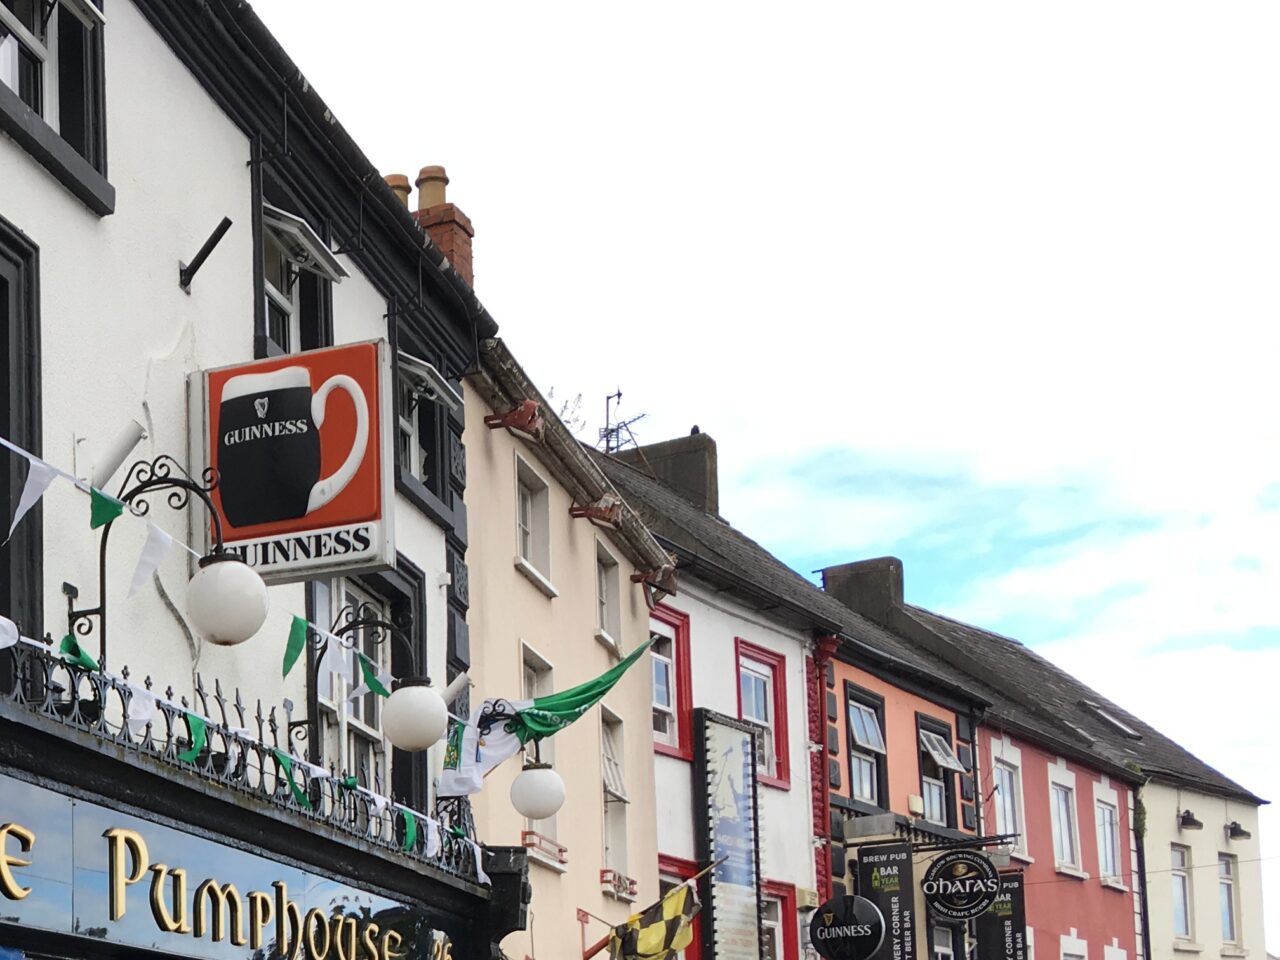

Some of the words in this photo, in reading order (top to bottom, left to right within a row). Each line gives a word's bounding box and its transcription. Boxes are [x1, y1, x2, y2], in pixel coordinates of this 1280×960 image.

[224, 418, 308, 446] GUINNESS
[863, 854, 888, 863] BREW
[890, 852, 907, 860] PUB
[880, 866, 899, 876] BAR
[881, 876, 899, 885] YEAR
[891, 896, 900, 936] CORNER
[933, 901, 948, 914] IRISH
[903, 910, 911, 929] BAR
[817, 924, 872, 939] GUINNESS
[1005, 920, 1013, 954] CORNER
[904, 930, 912, 951] BEER
